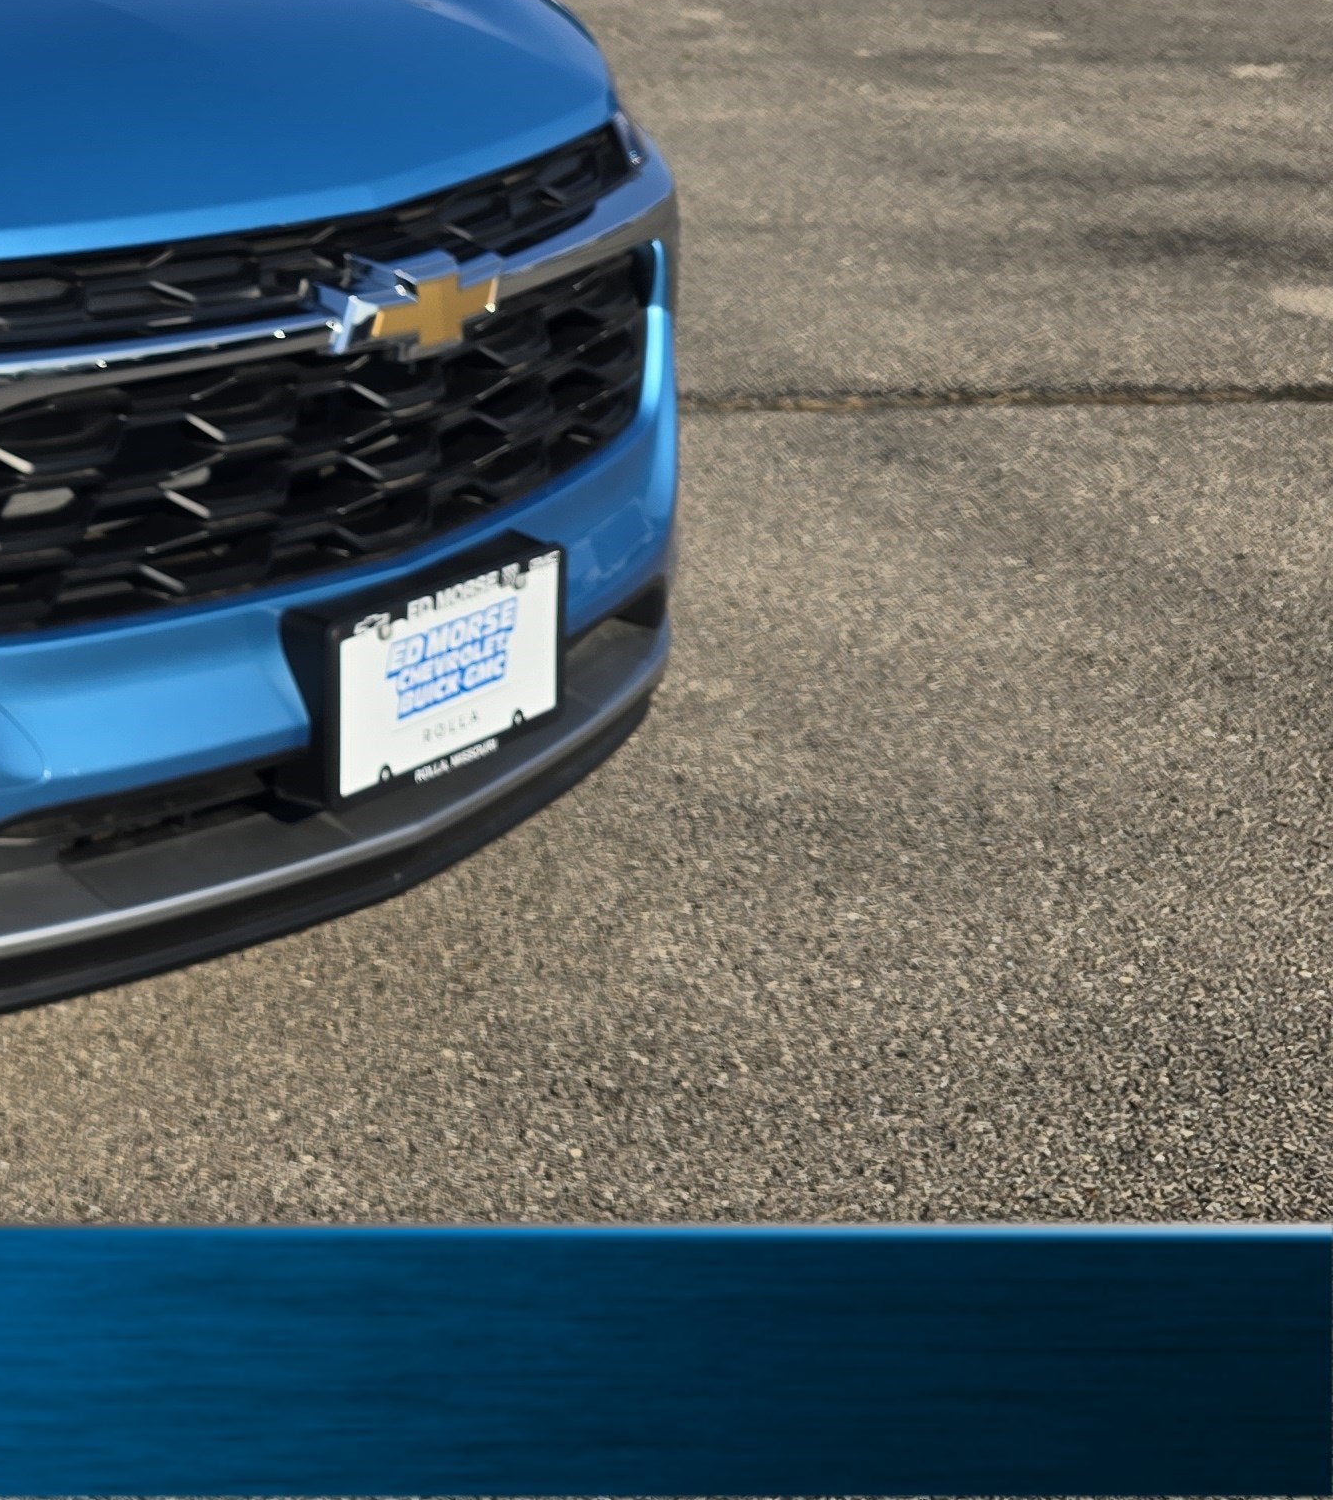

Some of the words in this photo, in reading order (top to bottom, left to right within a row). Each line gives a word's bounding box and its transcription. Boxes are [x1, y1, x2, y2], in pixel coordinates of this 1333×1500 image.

[387, 632, 428, 677] ED
[426, 596, 518, 660] MORSE
[396, 631, 509, 694] CHEVROLET
[460, 650, 507, 692] GMC
